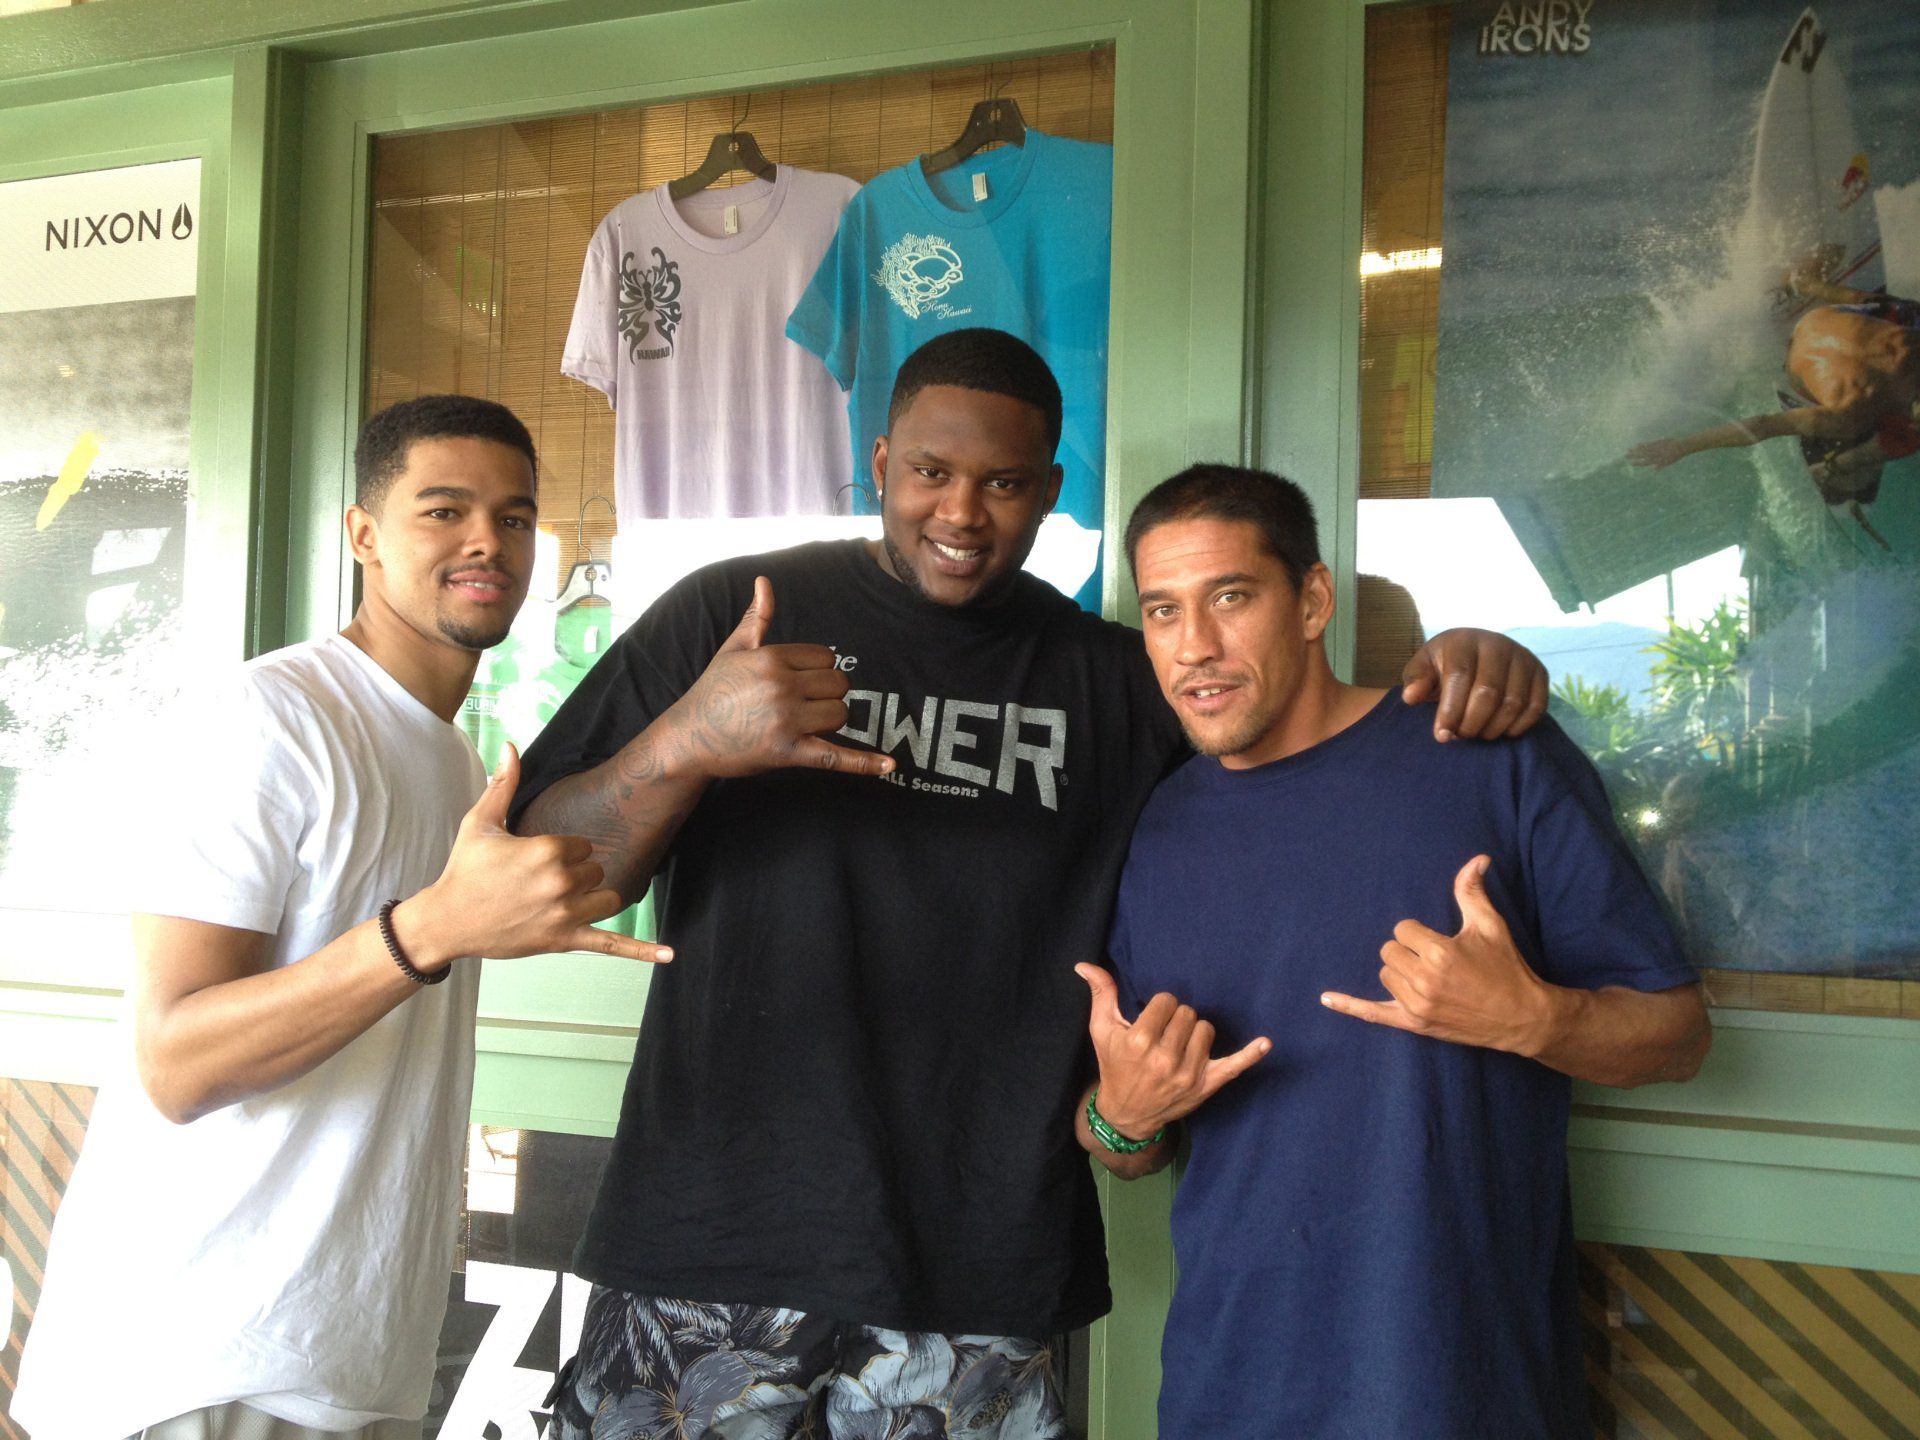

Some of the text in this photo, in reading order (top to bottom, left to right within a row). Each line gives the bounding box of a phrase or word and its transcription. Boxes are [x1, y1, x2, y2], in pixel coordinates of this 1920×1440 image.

[1491, 0, 1593, 26] ANDY
[1480, 23, 1591, 52] IRONS
[46, 208, 162, 251] NIXON
[636, 346, 671, 360] HAWAII
[836, 689, 1067, 812] OWER
[911, 777, 980, 798] Seasons
